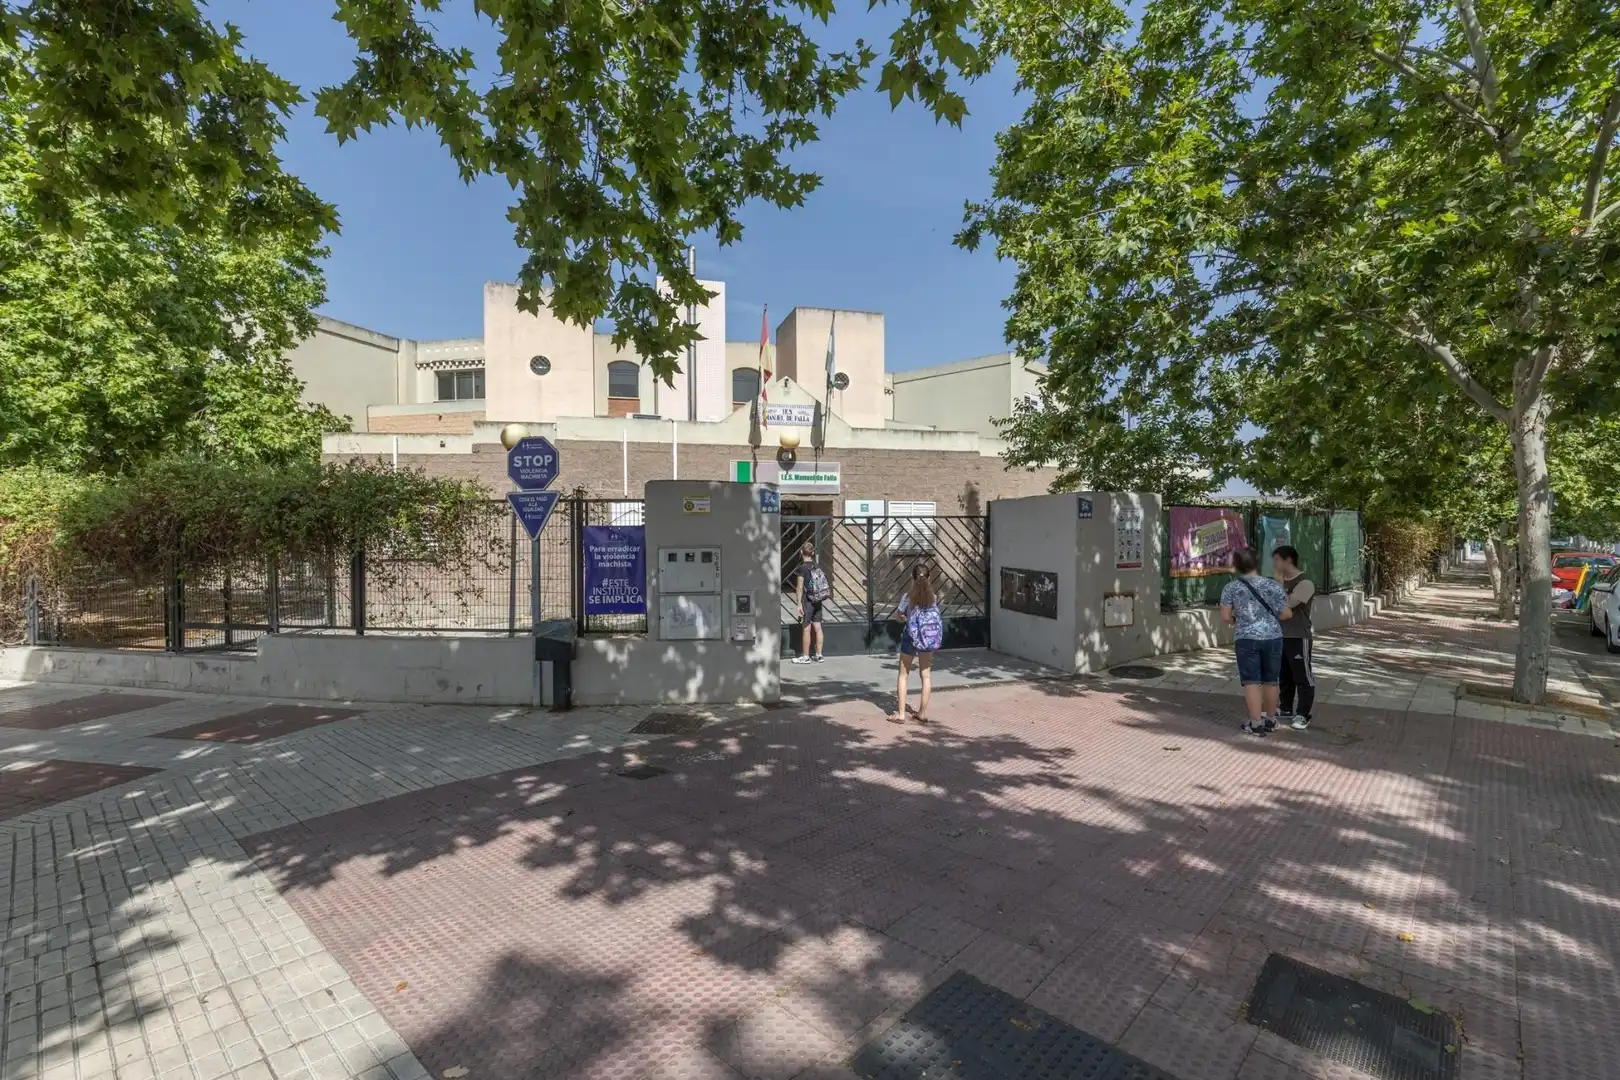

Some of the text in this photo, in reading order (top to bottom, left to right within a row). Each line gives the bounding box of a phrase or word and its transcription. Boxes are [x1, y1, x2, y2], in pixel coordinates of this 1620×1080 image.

[513, 455, 553, 467] STOP
[598, 560, 632, 568] machista
[602, 577, 629, 587] #ESTE
[592, 586, 639, 596] INSTITUTO
[588, 595, 643, 604] SE IMPLICA
